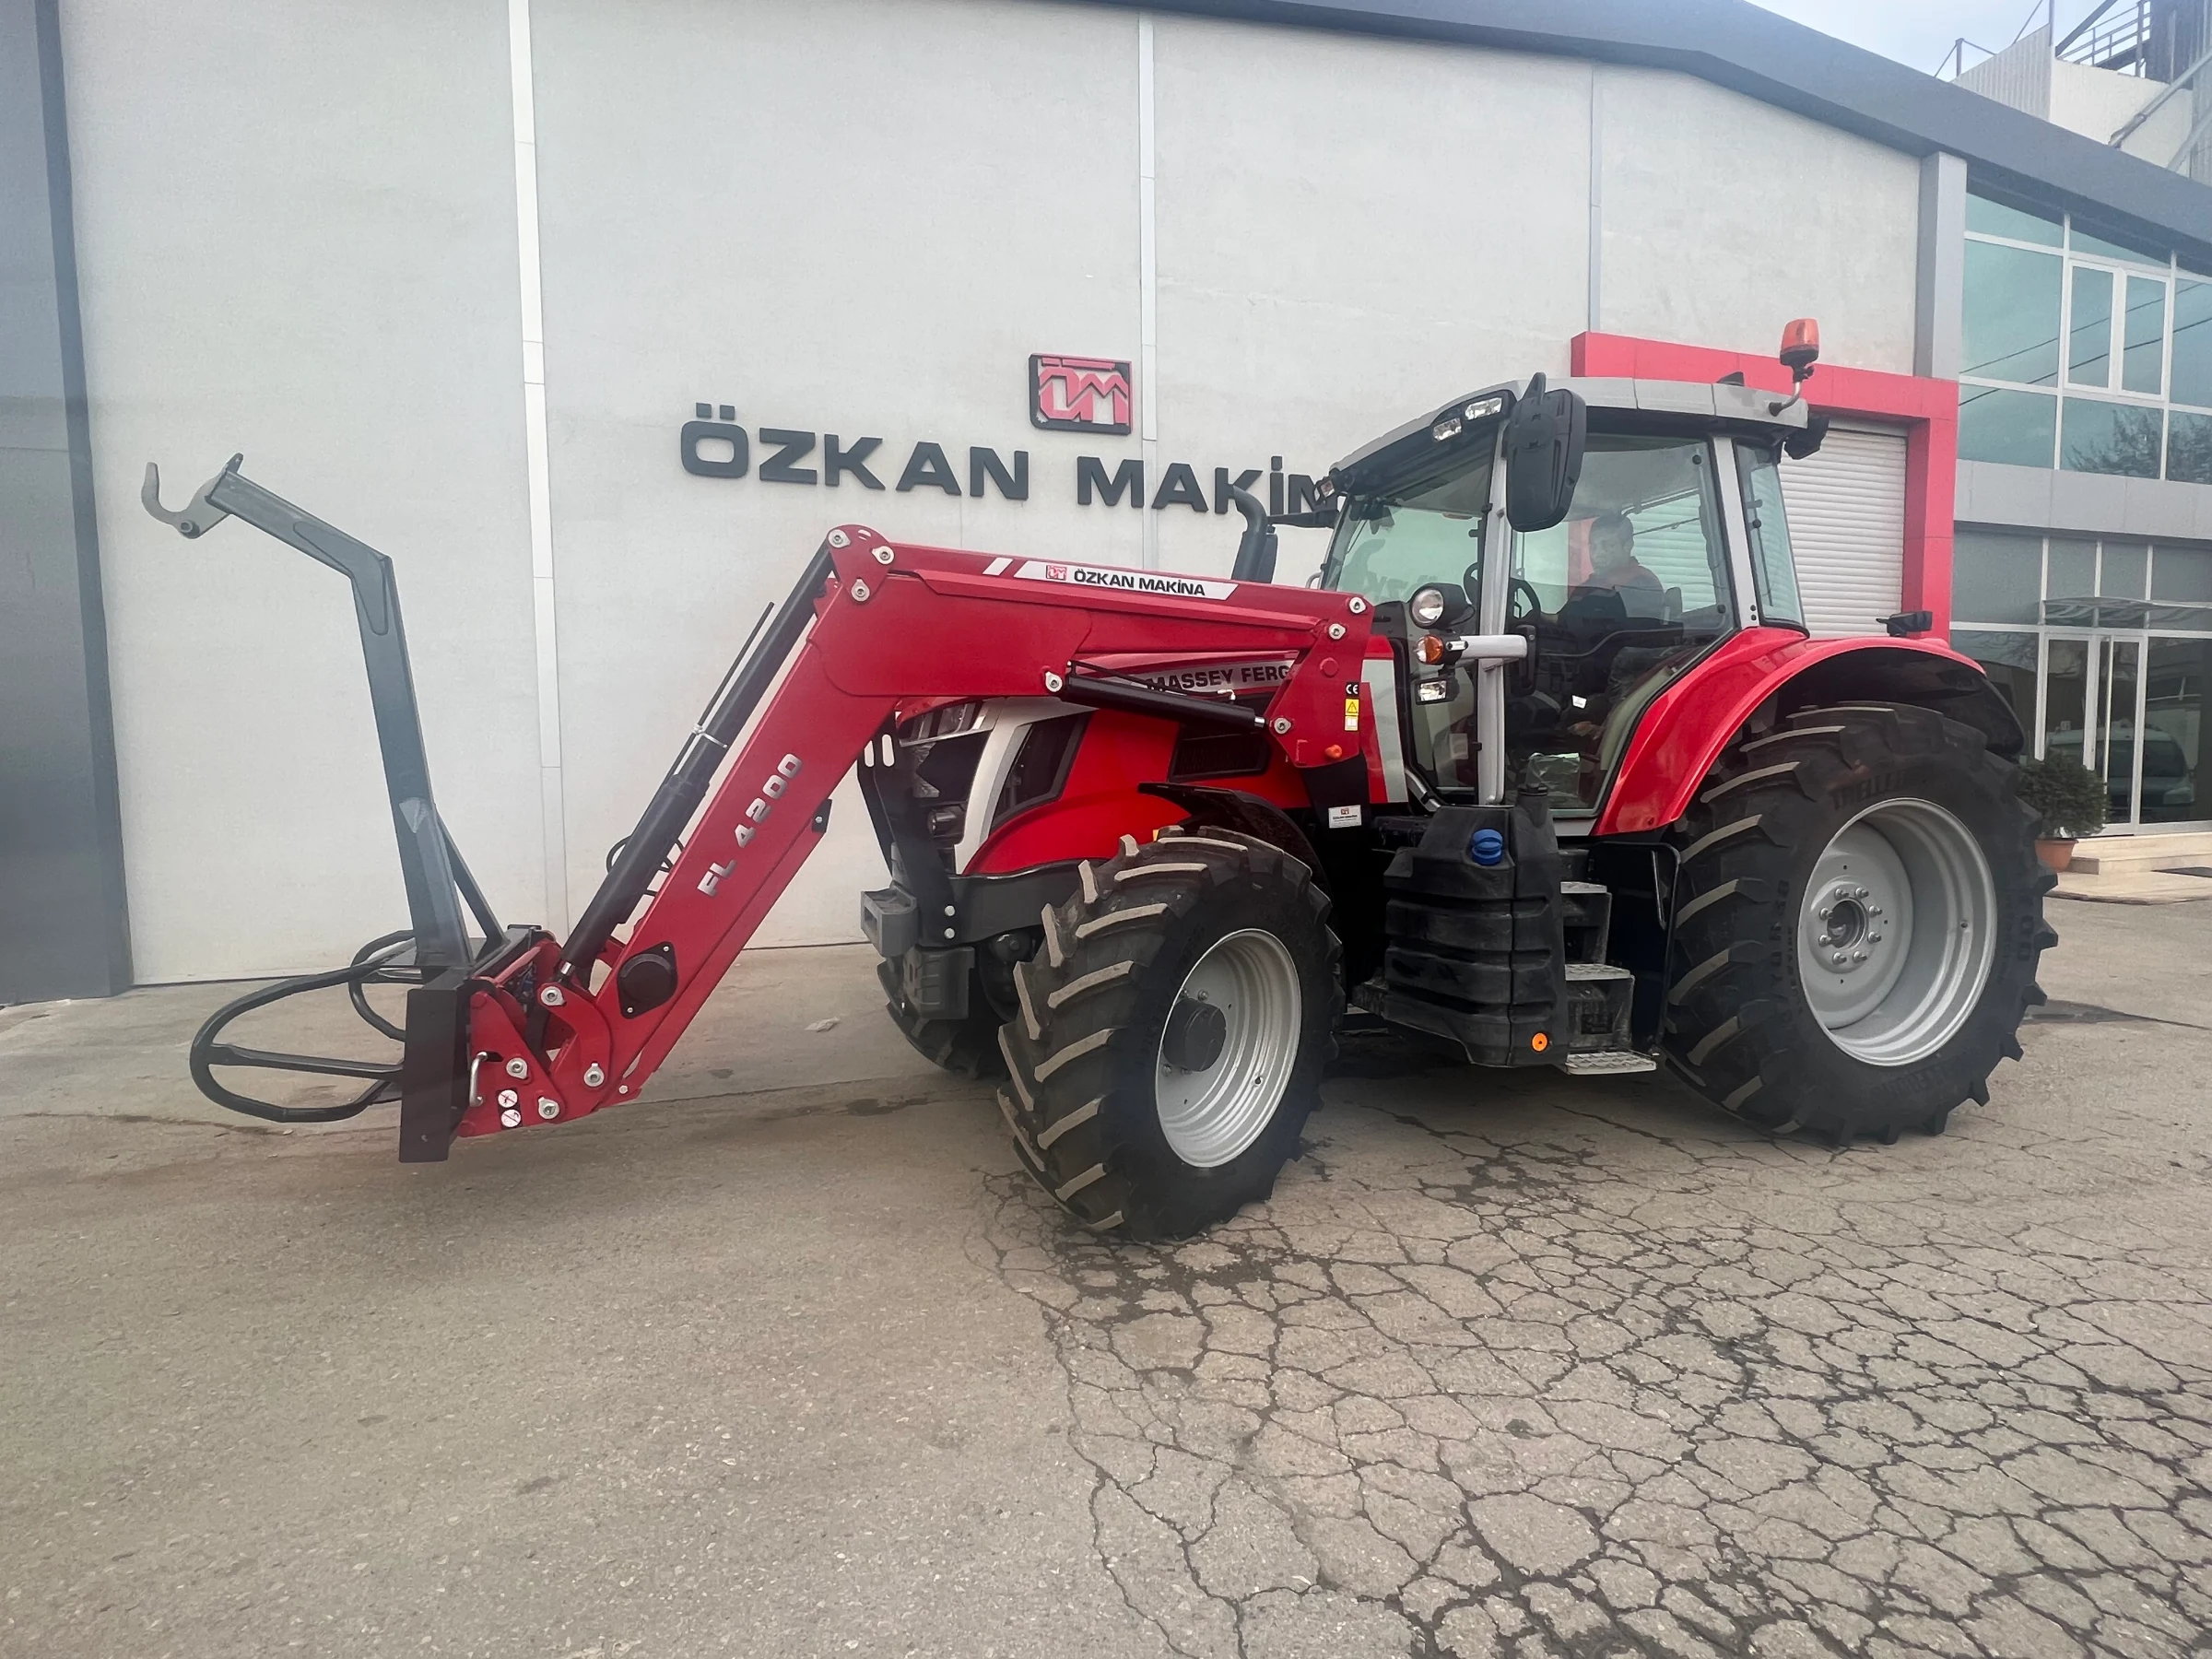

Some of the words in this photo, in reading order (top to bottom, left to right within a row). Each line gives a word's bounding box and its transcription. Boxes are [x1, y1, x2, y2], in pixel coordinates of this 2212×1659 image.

[680, 402, 1030, 500] ÖZKAN
[1074, 568, 1135, 588] ÖZKAN
[1138, 576, 1206, 596] MAKİNA
[697, 859, 737, 898] FL
[735, 753, 803, 849] 4200
